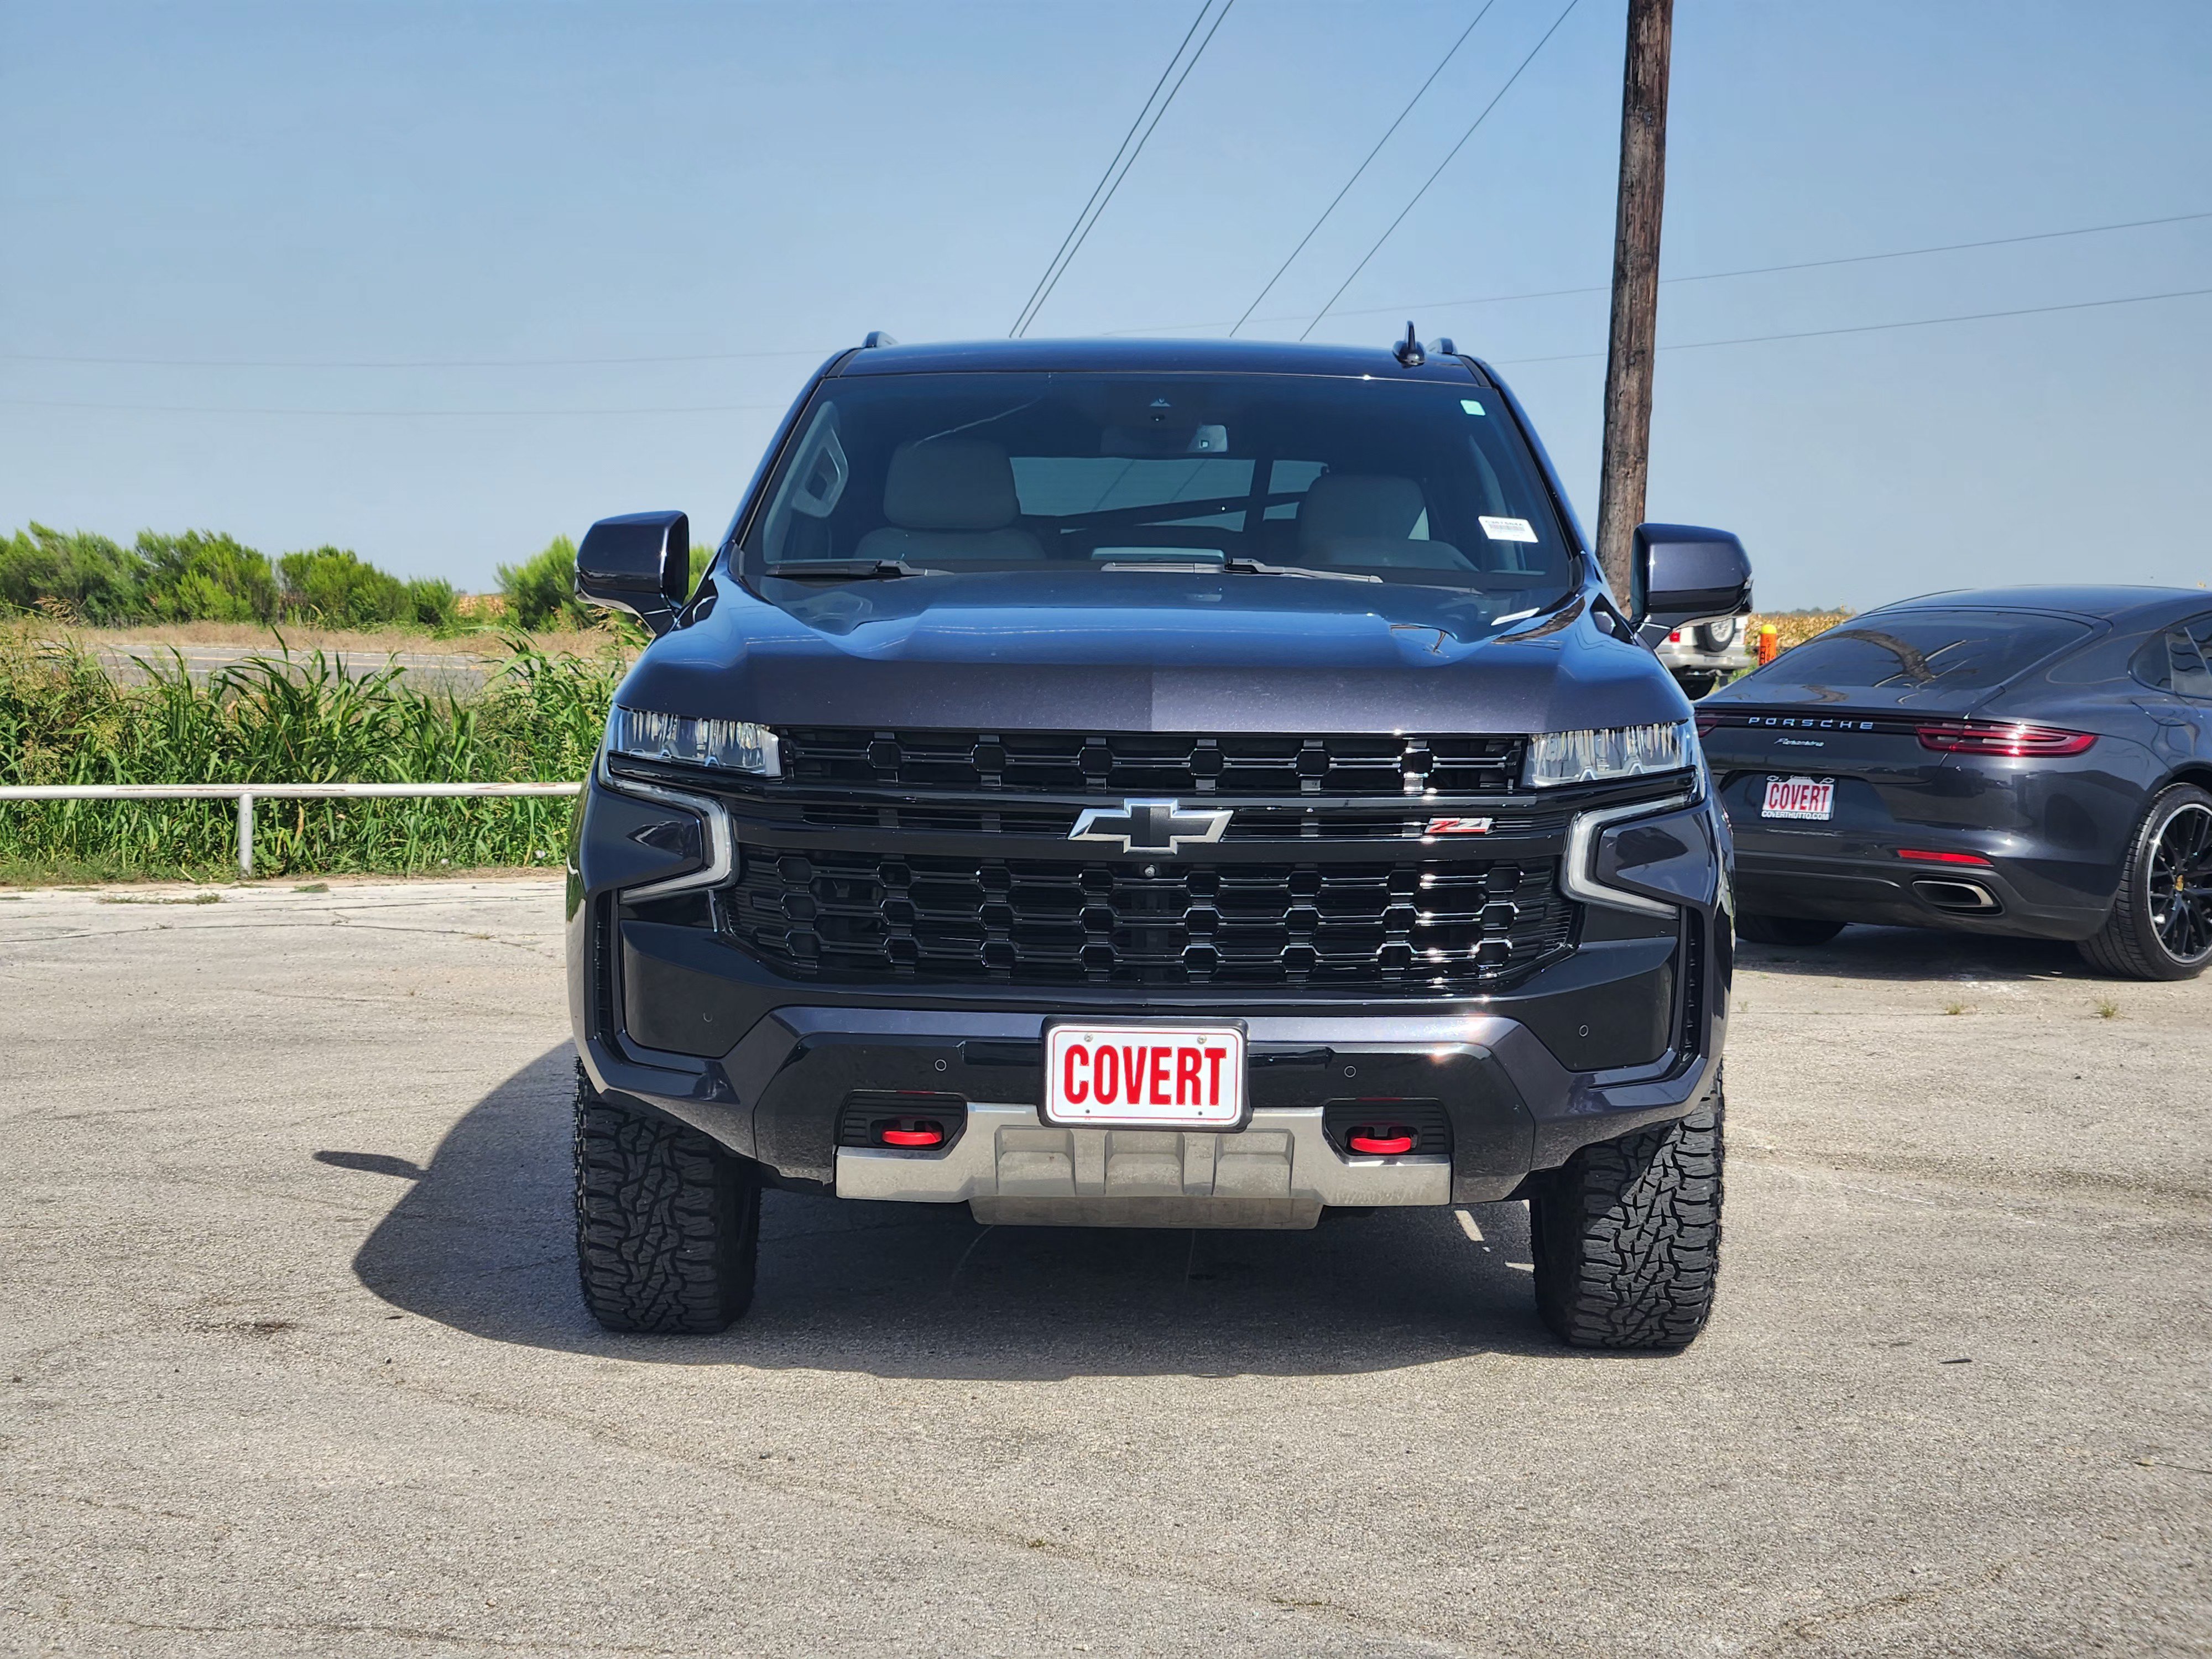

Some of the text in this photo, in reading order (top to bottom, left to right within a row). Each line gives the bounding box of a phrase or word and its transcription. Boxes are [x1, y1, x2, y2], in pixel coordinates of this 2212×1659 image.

[1748, 717, 1874, 729] PORSCHE
[1769, 783, 1830, 812] COVERT
[1761, 811, 1829, 820] COVERTHUTTO.COM
[1064, 1044, 1227, 1105] COVERT
